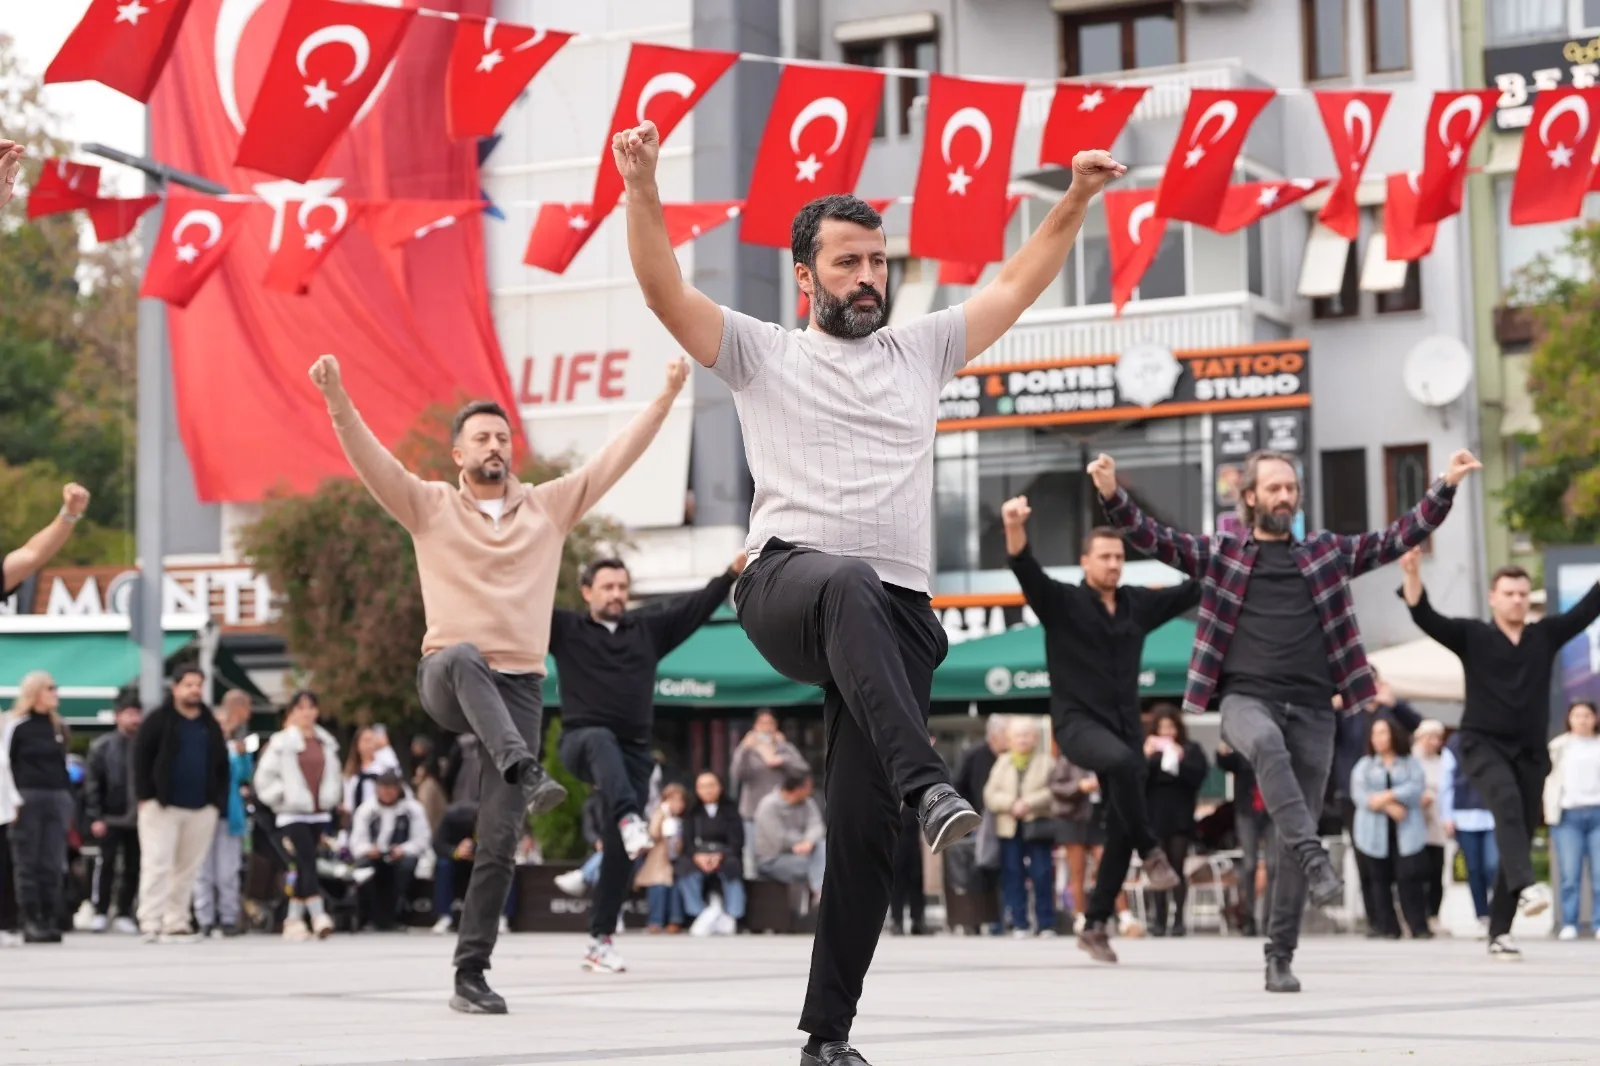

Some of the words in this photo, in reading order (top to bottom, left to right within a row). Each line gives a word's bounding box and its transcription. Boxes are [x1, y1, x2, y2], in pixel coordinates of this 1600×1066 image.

[520, 349, 630, 404] LIFE
[1008, 364, 1115, 396] PORTRE
[1191, 353, 1304, 379] TATTOO
[1195, 373, 1300, 400] STUDIO
